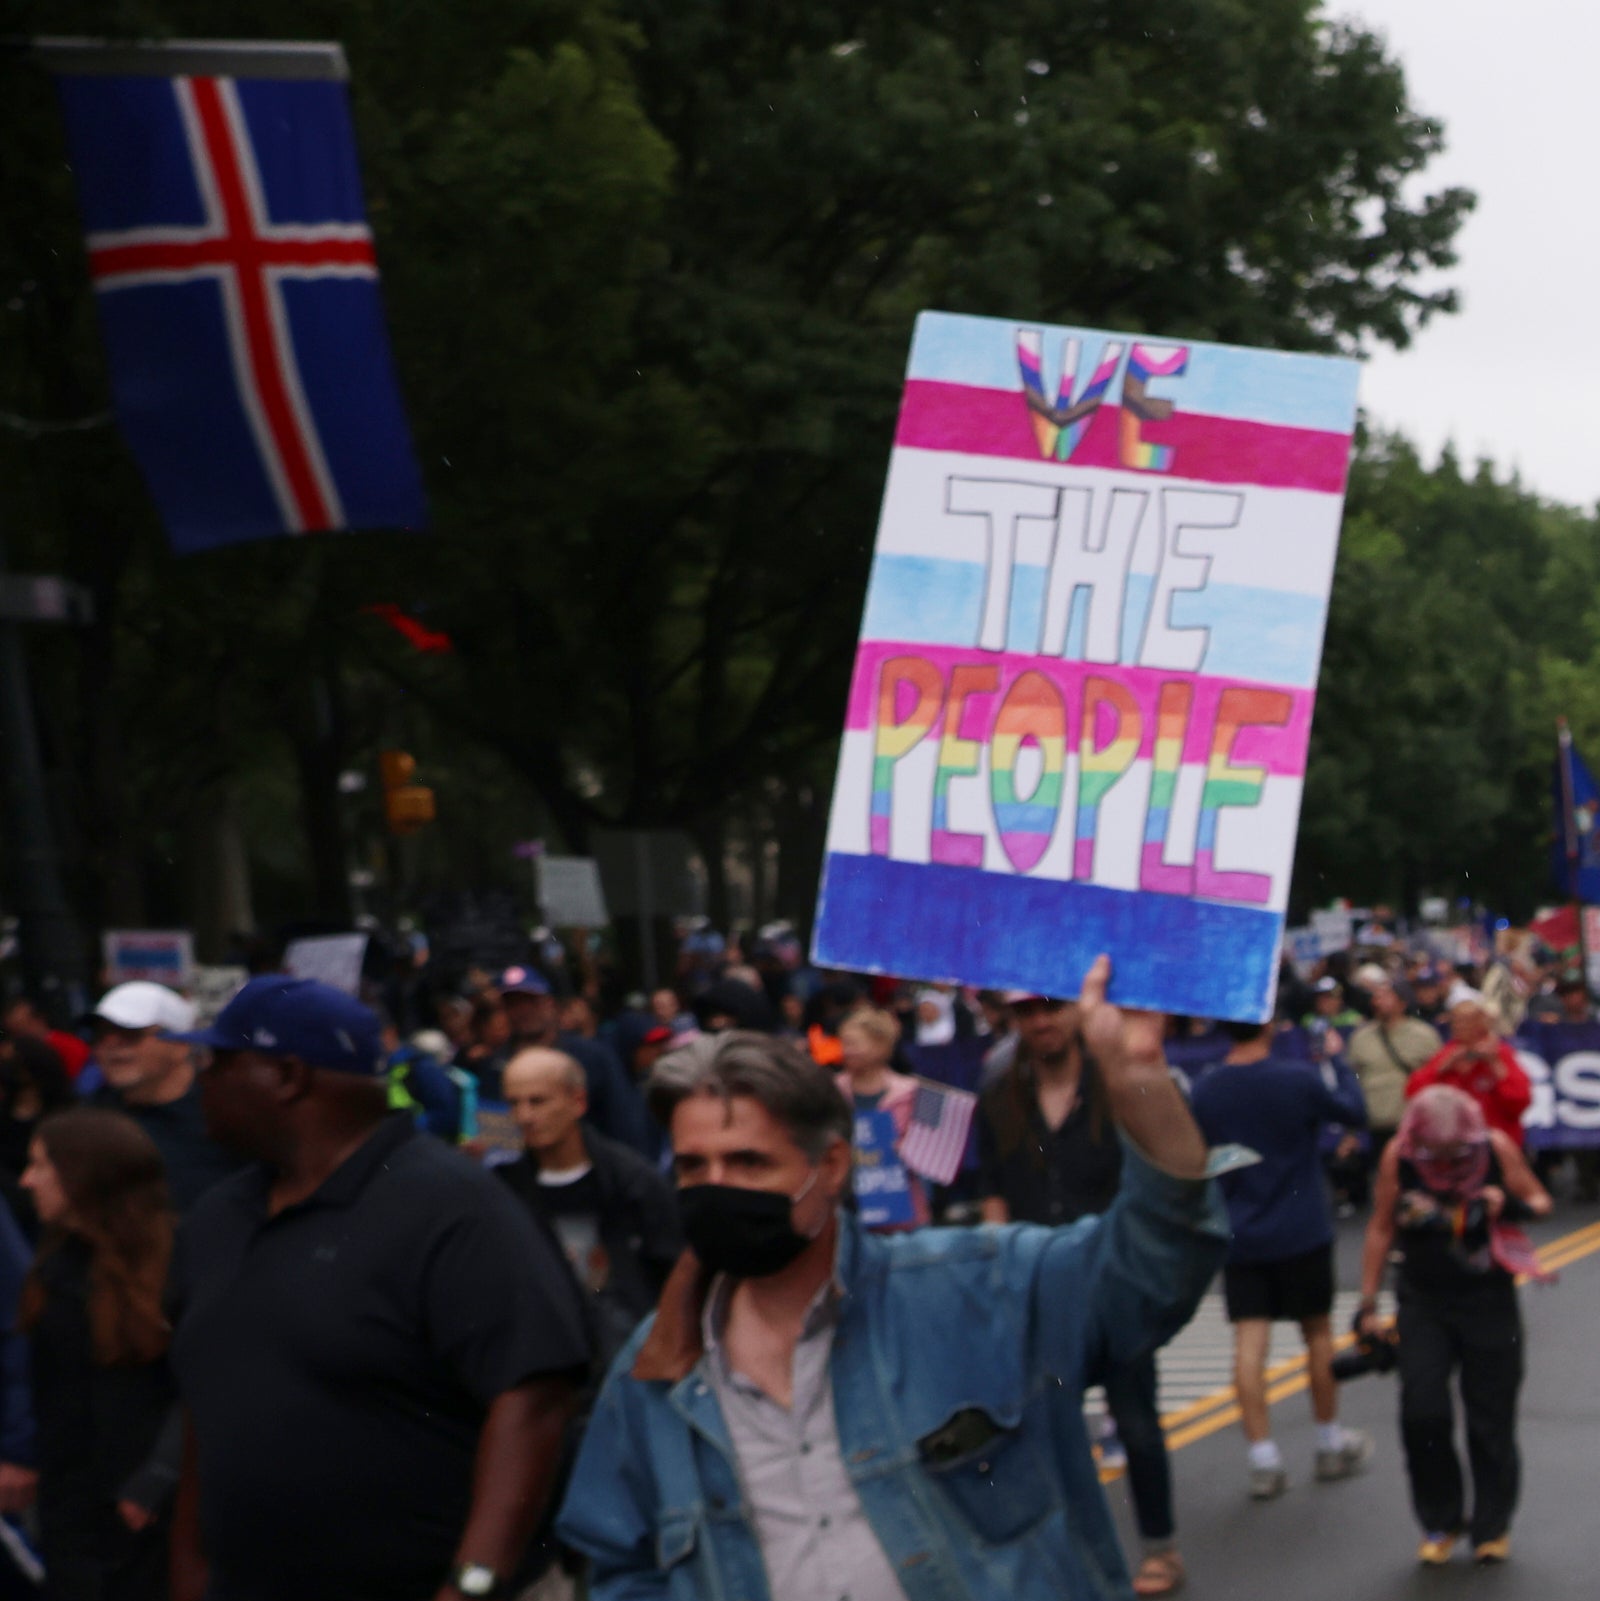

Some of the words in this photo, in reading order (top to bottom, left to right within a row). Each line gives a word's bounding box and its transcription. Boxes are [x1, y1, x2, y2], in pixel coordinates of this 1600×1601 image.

[1015, 328, 1192, 472] WE
[945, 474, 1245, 673] THE
[869, 656, 1293, 904] PEOPLE
